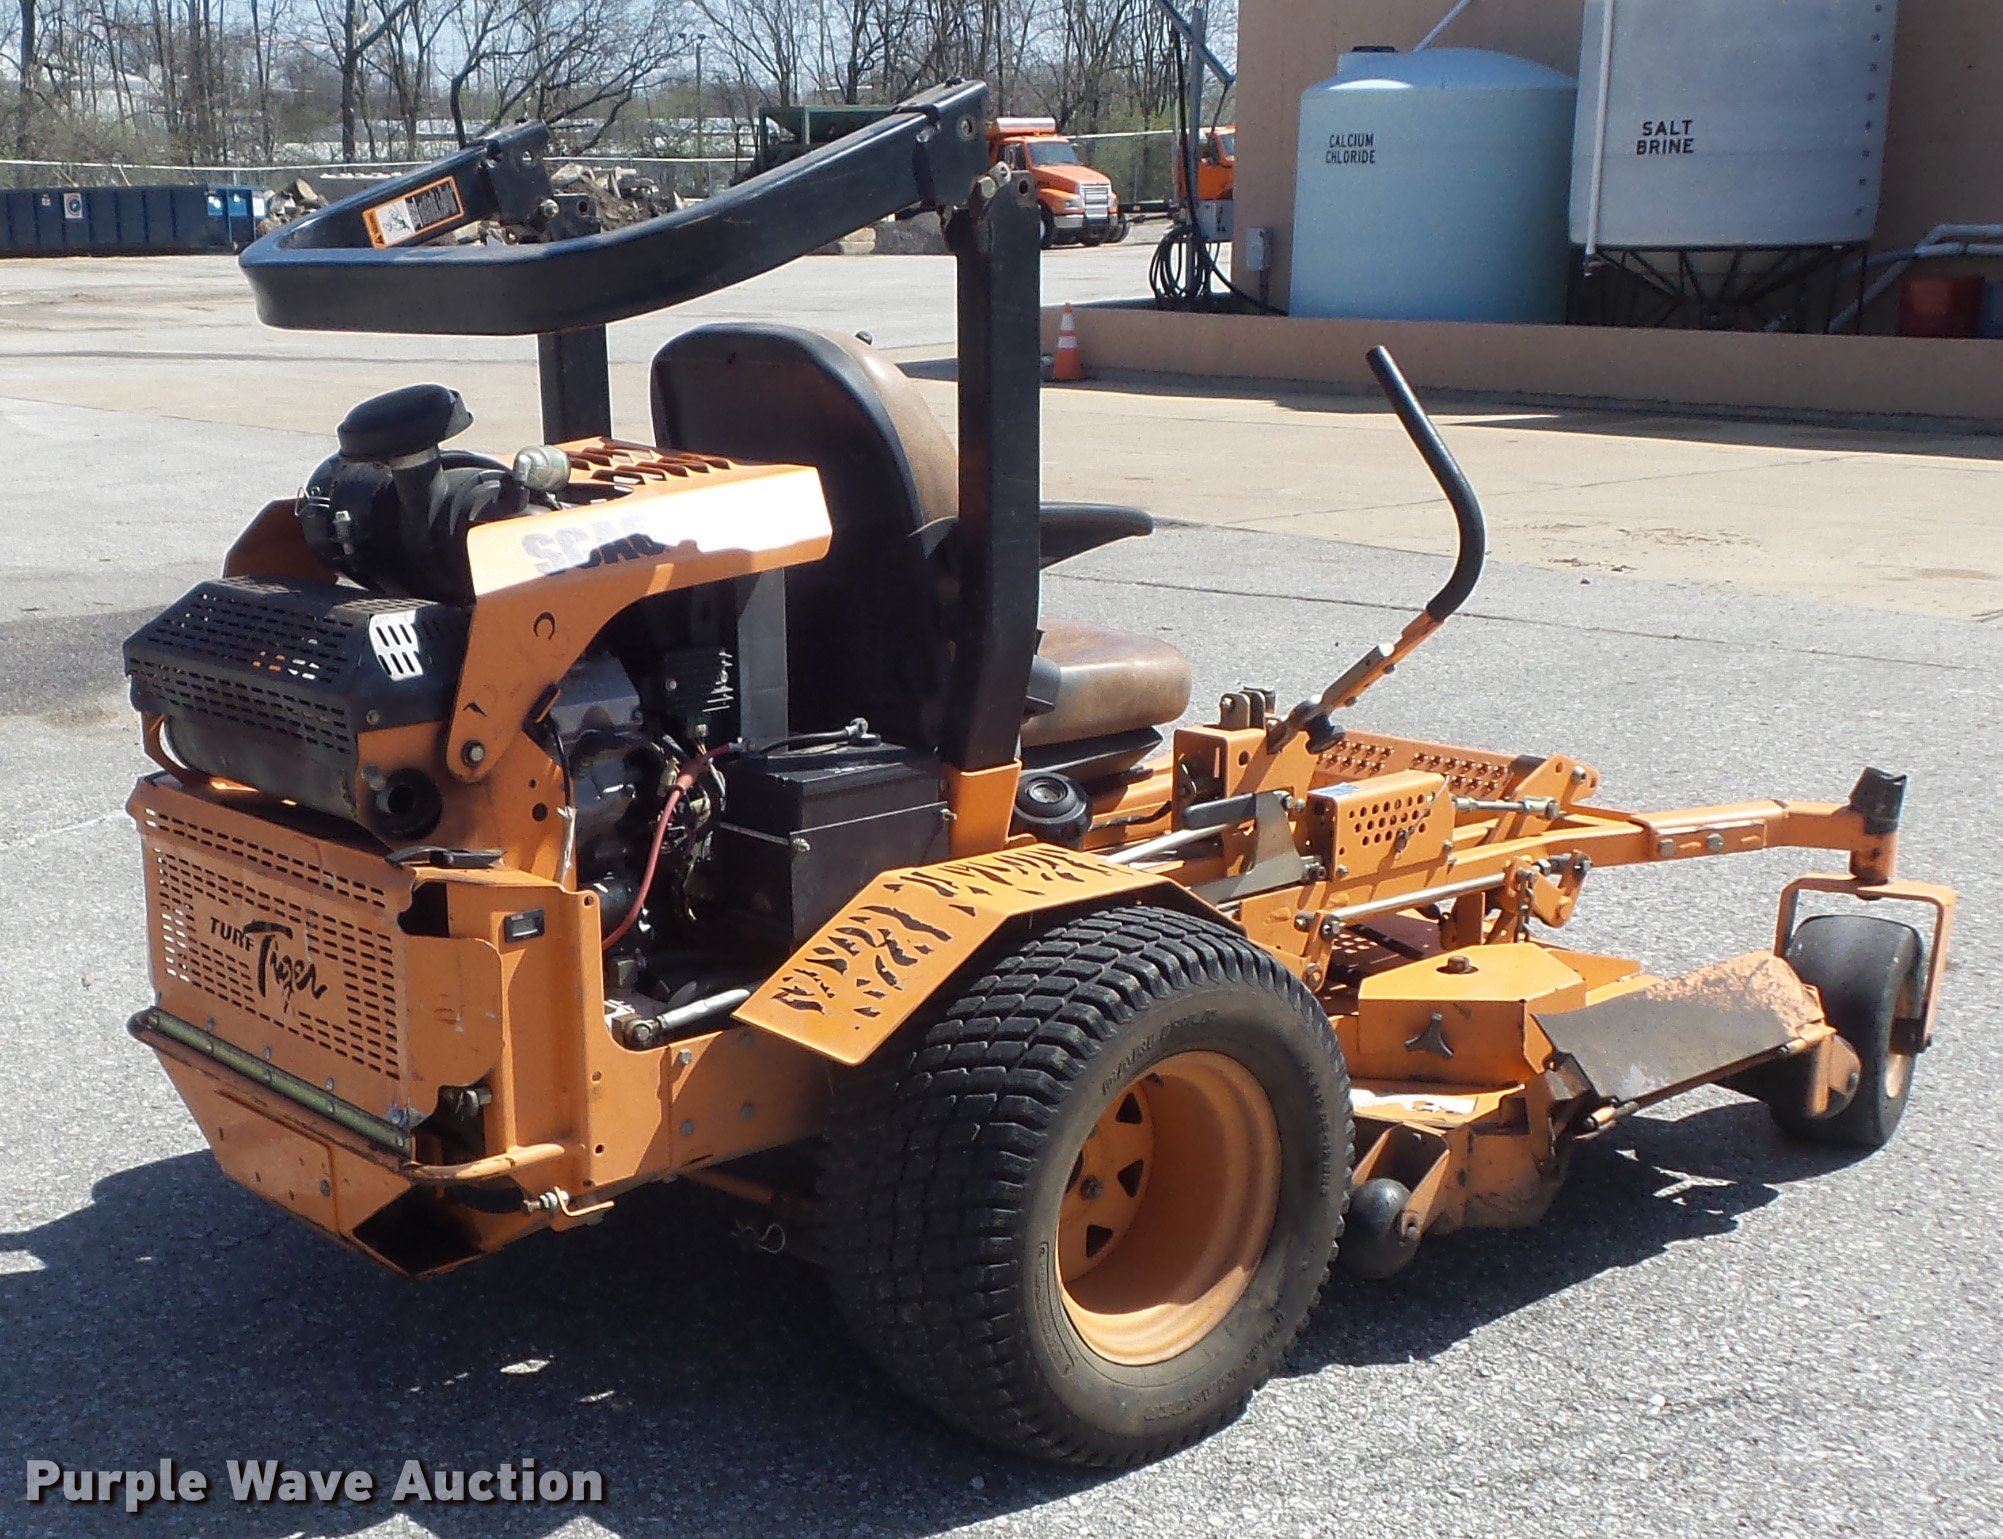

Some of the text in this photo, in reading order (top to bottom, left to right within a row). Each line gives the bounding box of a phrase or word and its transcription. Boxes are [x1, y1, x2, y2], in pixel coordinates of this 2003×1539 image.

[1642, 119, 1693, 137] SALT
[1329, 133, 1374, 148] CALCIUM
[1636, 138, 1695, 155] BRINE
[1325, 149, 1376, 164] CHLORIDE
[210, 916, 328, 1014] TURF Tiger
